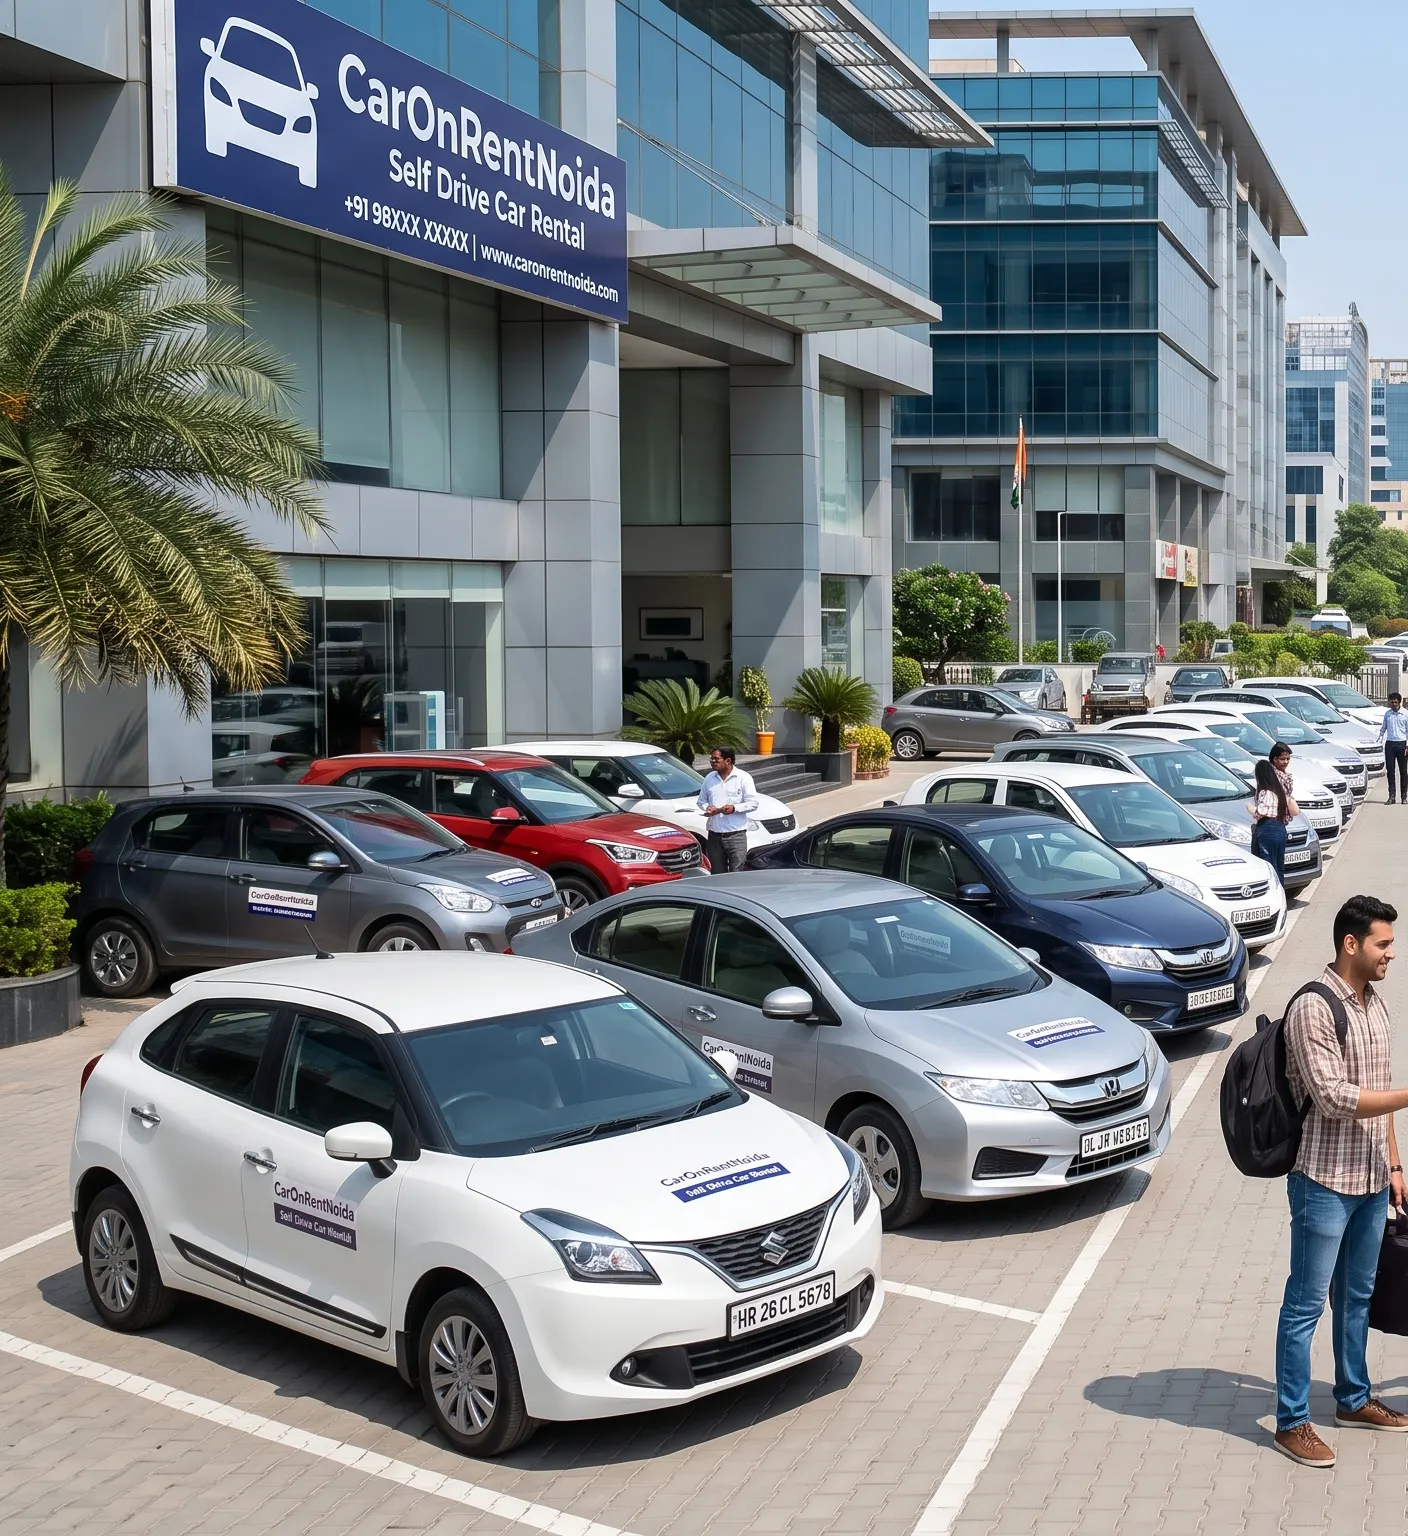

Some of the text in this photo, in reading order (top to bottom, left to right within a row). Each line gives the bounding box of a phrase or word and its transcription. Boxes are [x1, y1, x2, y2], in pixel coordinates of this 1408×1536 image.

[338, 53, 615, 219] CarOnRentNoida
[344, 194, 369, 222] +91
[372, 203, 421, 238] 98XXX
[423, 218, 469, 254] XXXXX
[480, 242, 619, 303] www.caronrentnoida.com
[388, 148, 586, 250] Self Drive Car Rental
[274, 1181, 354, 1222] CarOnRentNoida
[738, 1281, 831, 1330] HR 26 CL 5678
